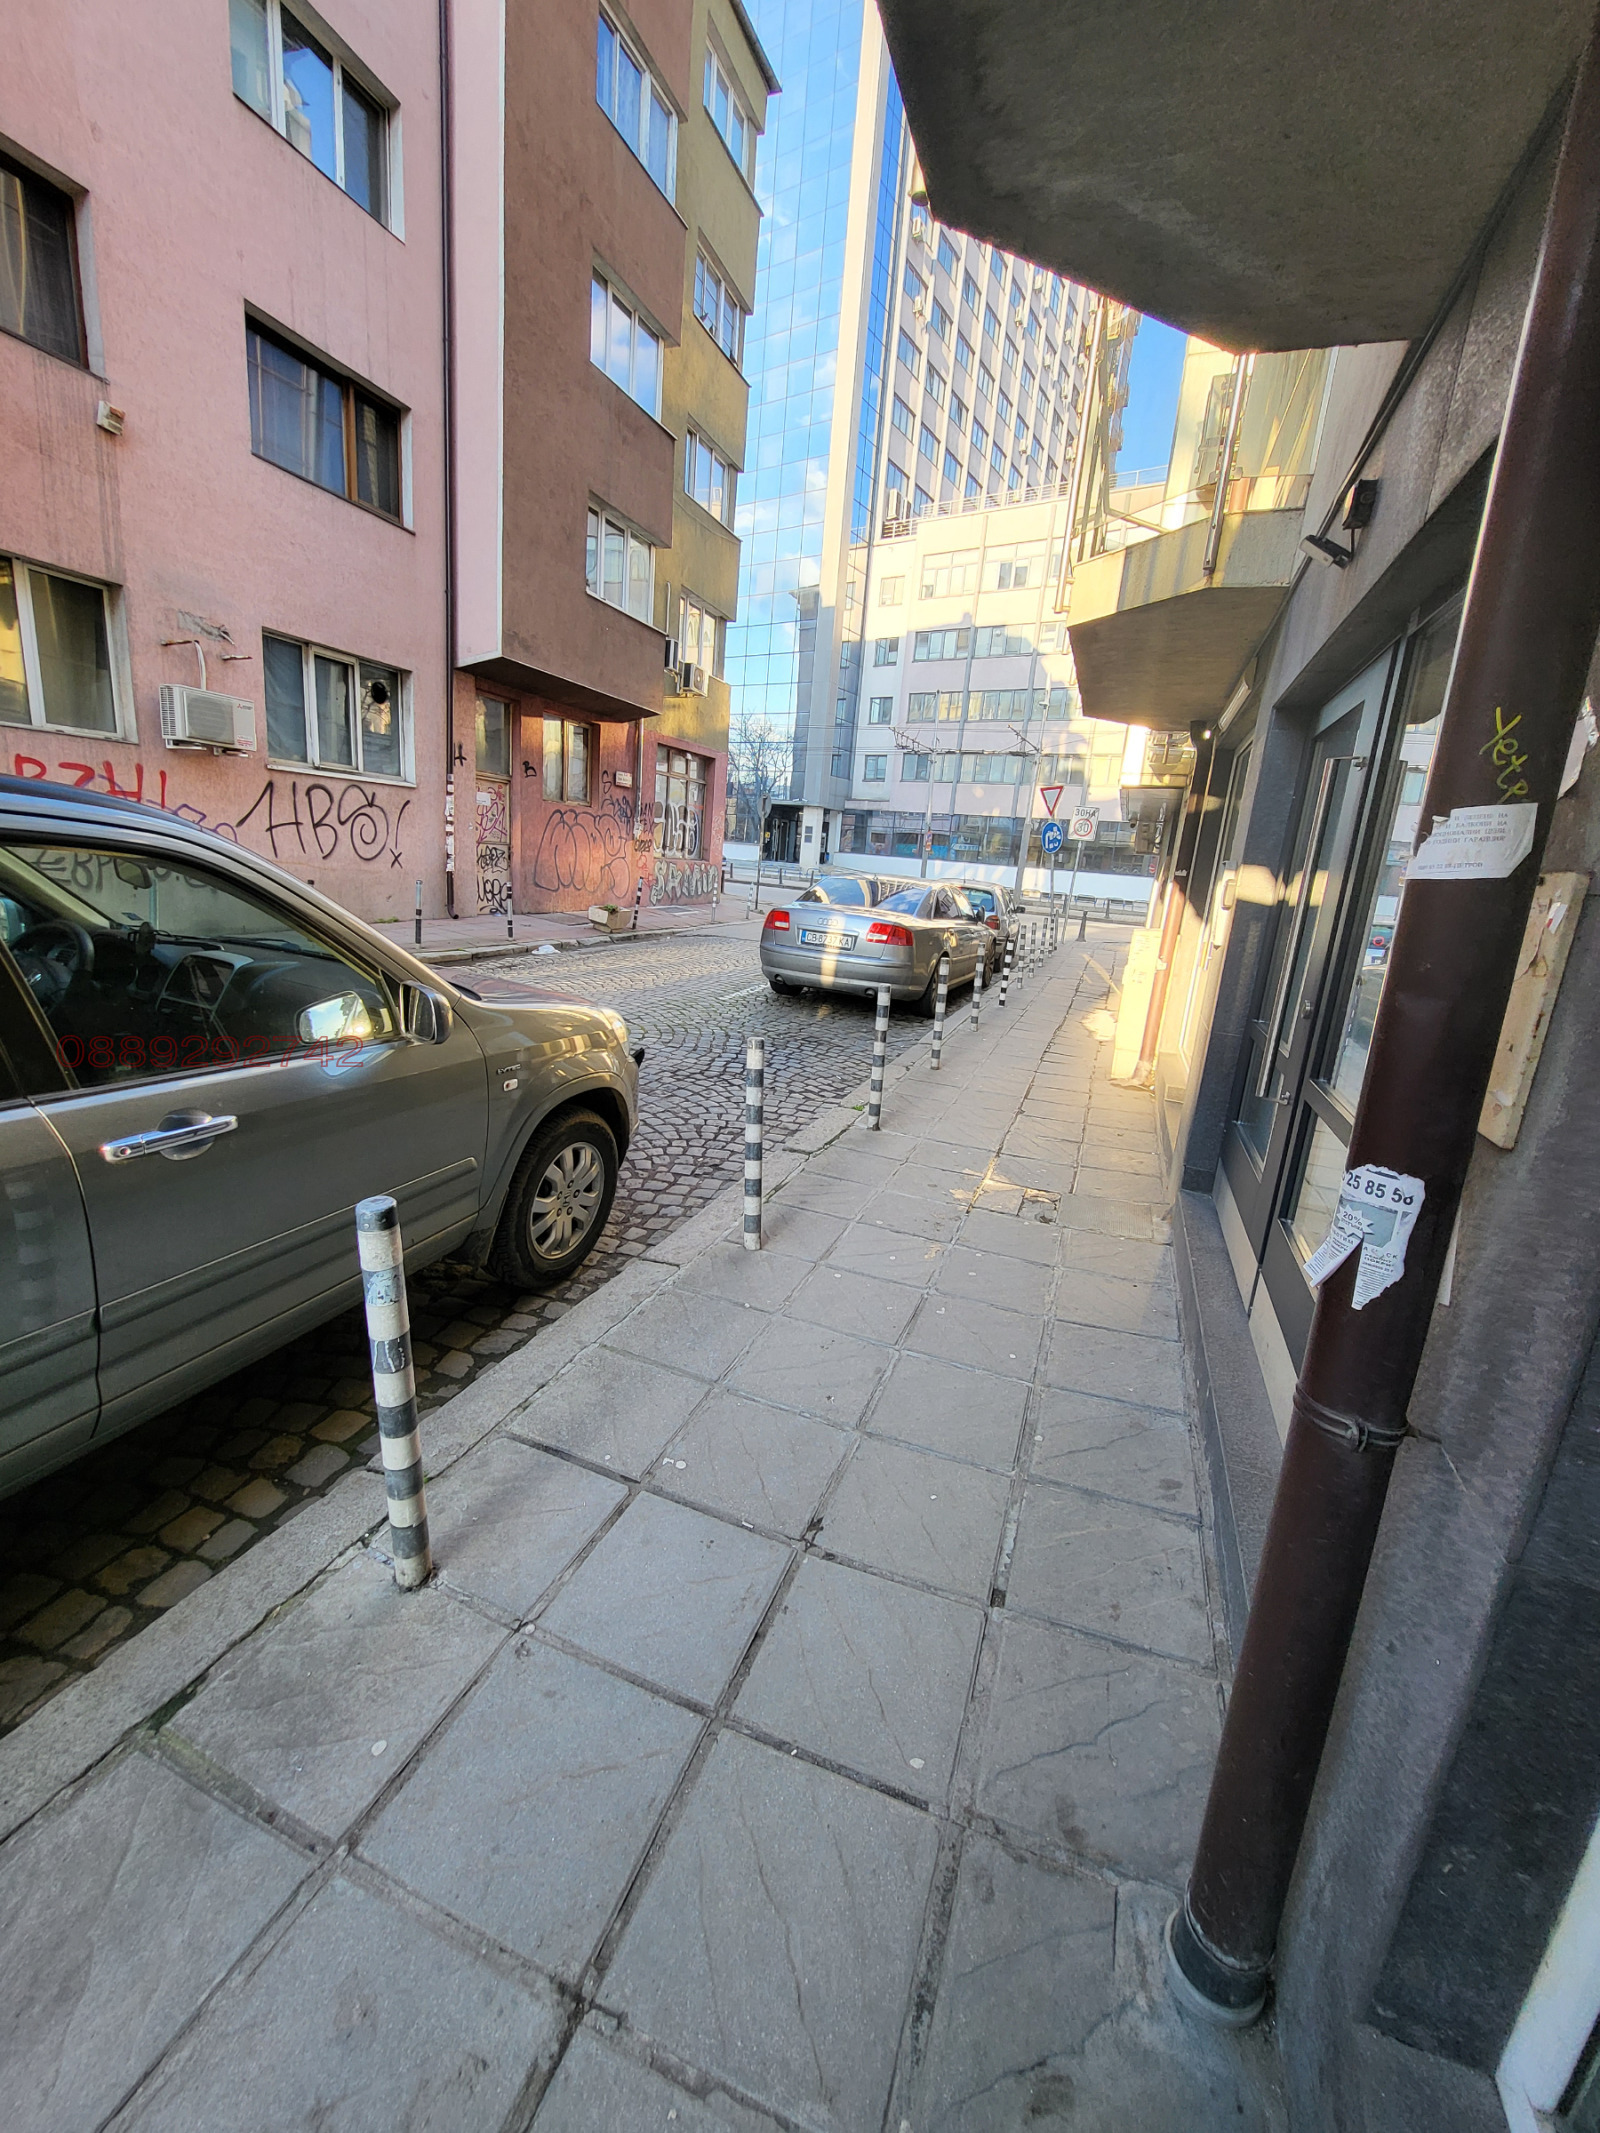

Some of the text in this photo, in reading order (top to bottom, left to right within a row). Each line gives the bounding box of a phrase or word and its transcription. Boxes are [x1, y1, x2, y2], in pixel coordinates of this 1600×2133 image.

[1075, 808, 1097, 817] ЗОНА
[1076, 822, 1090, 833] 30
[806, 932, 850, 947] CB 8737 KA
[1364, 1179, 1387, 1199] 85
[1342, 1211, 1363, 1226] 20%
